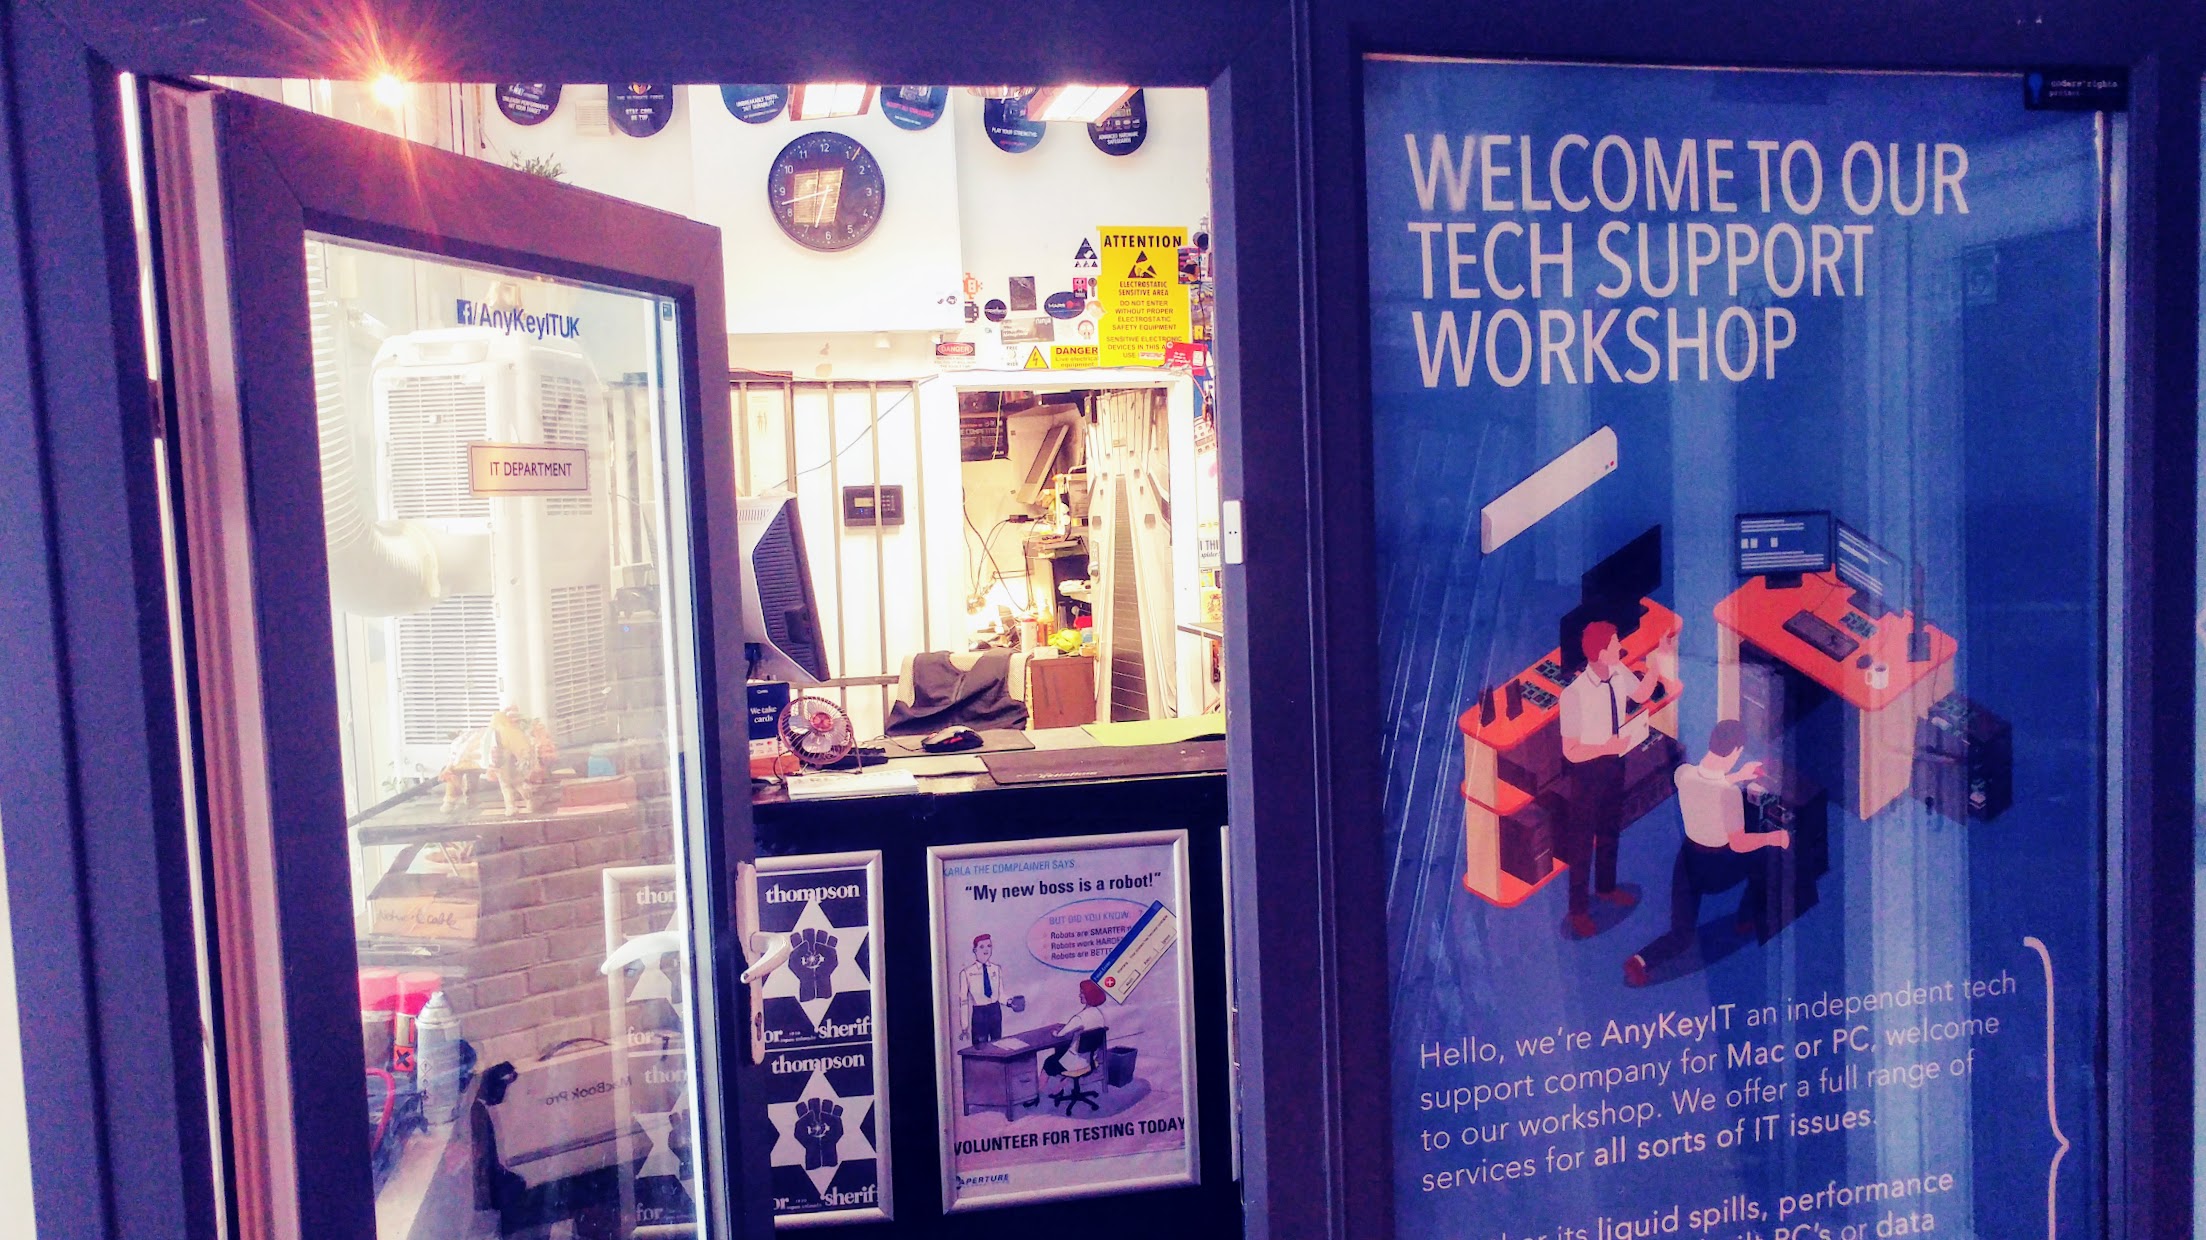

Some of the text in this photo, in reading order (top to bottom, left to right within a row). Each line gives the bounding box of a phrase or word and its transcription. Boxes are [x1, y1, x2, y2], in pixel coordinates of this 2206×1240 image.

[820, 143, 830, 152] 12
[799, 150, 807, 159] 11
[846, 151, 850, 159] 1
[785, 165, 794, 174] 10
[859, 165, 865, 175] 2
[1405, 133, 1970, 216] WELCOME TO OUR
[780, 187, 786, 196] 9
[866, 188, 872, 196] 3
[787, 208, 793, 217] 8
[862, 209, 868, 217] 4
[804, 225, 810, 233] 7
[826, 231, 832, 240] 6
[847, 225, 853, 234] 5
[1104, 235, 1182, 248] ATTENTION
[1407, 220, 1874, 301] TECH SUPPORT
[1056, 347, 1098, 355] DANGER
[1411, 307, 1797, 389] WORKSHOP
[490, 462, 573, 477] IT DEPARTMENT
[1205, 540, 1219, 550] THI
[750, 705, 778, 715] We take
[754, 715, 774, 724] cards
[973, 864, 990, 875] THE
[992, 860, 1050, 875] COMPLAINER
[1052, 859, 1075, 870] SAYS
[765, 883, 860, 904] thompson
[1002, 883, 1035, 899] new
[1039, 879, 1074, 895] boss
[1078, 877, 1092, 893] is
[1096, 880, 1105, 892] a
[1049, 915, 1065, 925] BUT
[1068, 914, 1082, 924] DID
[1084, 913, 1100, 922] YOU
[1051, 930, 1075, 940] Robots
[1090, 926, 1126, 936] SMARTER
[1051, 940, 1075, 950] Robots
[1077, 939, 1095, 948] work
[1051, 951, 1076, 961] Robots
[1077, 951, 1089, 959] are
[1420, 1035, 1505, 1070] Hello,
[1601, 1003, 1736, 1049] AnyKeyIT
[1746, 1005, 1777, 1027] an
[1786, 979, 1954, 1021] independent
[1963, 969, 2016, 1000] tech
[628, 1026, 655, 1045] for
[764, 1028, 783, 1043] or
[818, 1015, 872, 1039] sherif
[771, 1053, 866, 1075] thompson
[1420, 1016, 2000, 1114] support company for Mac or PC, welcome
[1420, 1048, 1975, 1152] to our workshop. We offer a full range of
[954, 1117, 1185, 1156] VOLUNTEER FOR TESTING TODAY
[1422, 1107, 1878, 1193] services for all sorts of IT issues.
[824, 1184, 878, 1206] sherif
[635, 1203, 664, 1221] for
[1556, 1172, 1955, 1240] its liquid spills, performance
[1841, 1222, 1868, 1240] or
[1876, 1210, 1935, 1239] data
